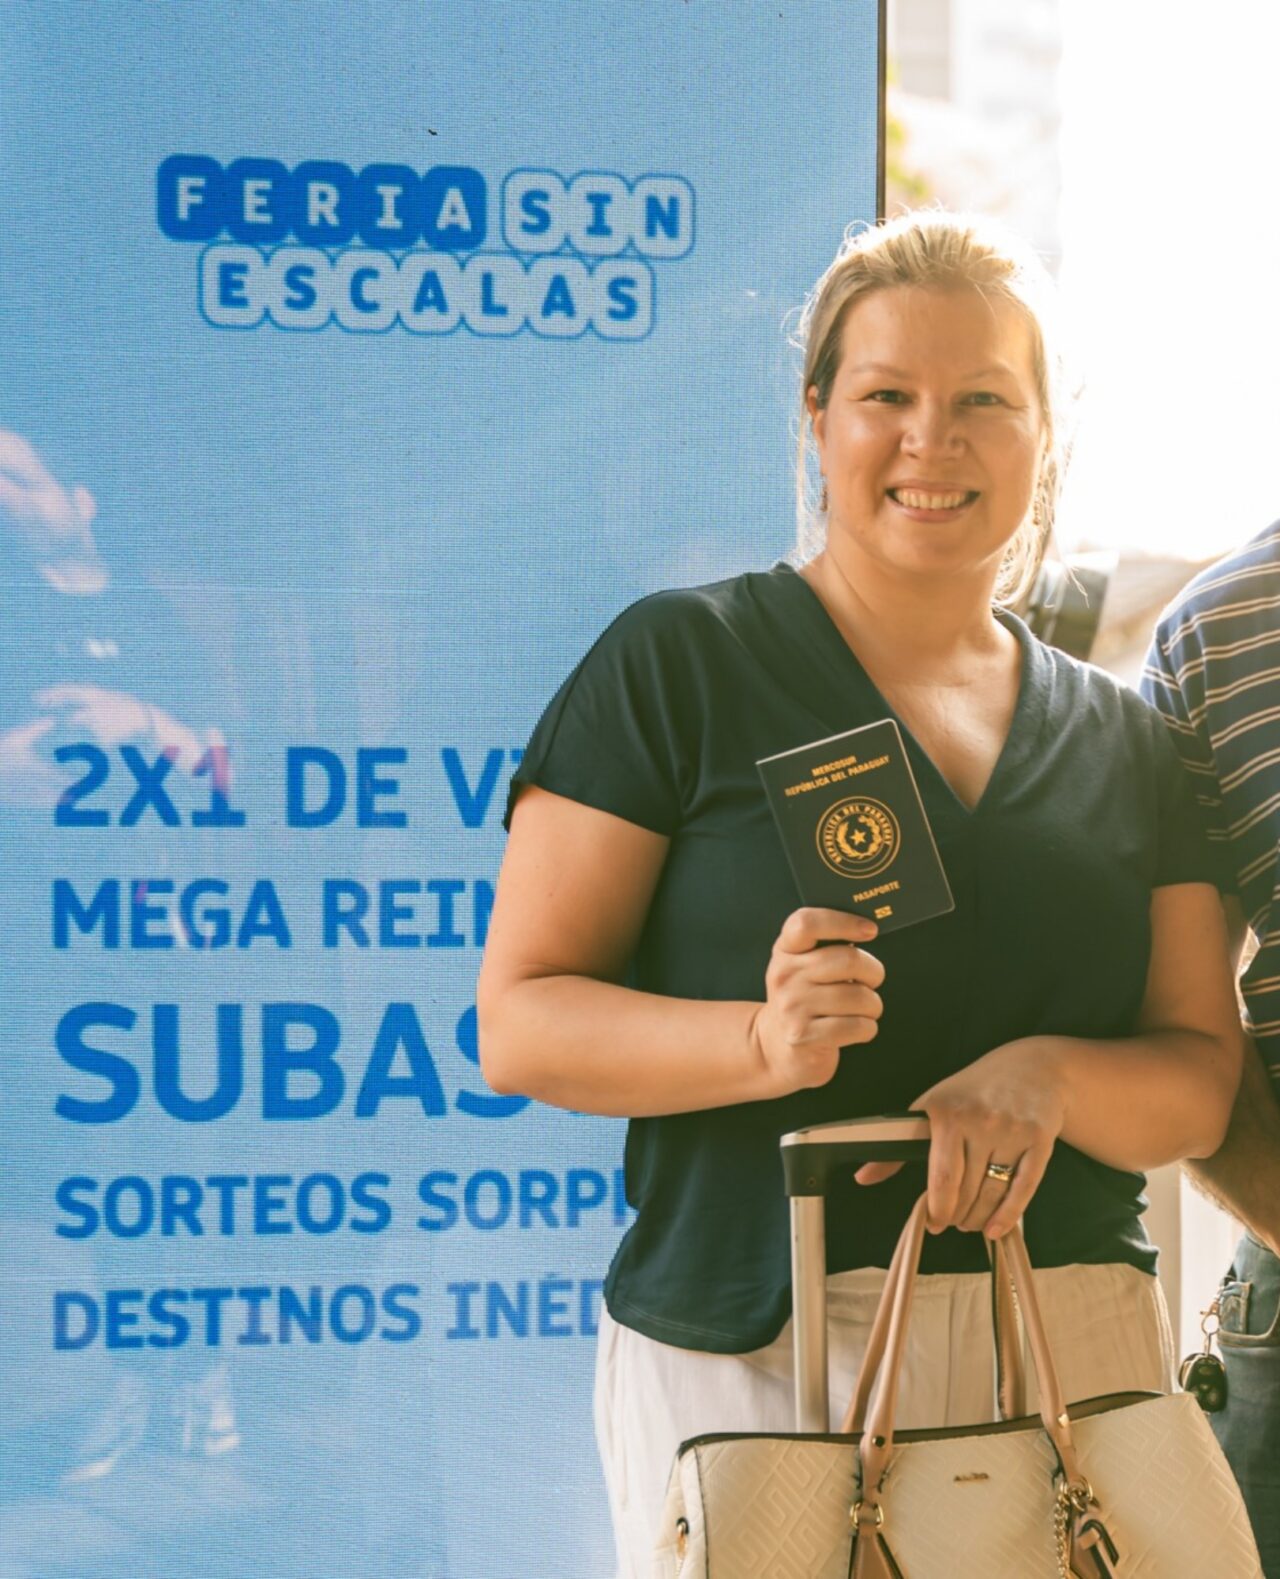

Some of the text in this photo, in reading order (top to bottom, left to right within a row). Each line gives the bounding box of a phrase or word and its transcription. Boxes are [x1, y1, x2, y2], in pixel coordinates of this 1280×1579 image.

[176, 176, 680, 241] FERIA SIN
[218, 262, 639, 321] ESCALAS
[53, 742, 247, 829] 2X1
[285, 746, 409, 829] DE
[812, 755, 857, 776] MERCOSUR
[831, 772, 847, 782] DEL
[848, 755, 889, 775] PARAGUAY
[51, 878, 293, 950] MEGA
[853, 880, 900, 902] PASAPORTE
[54, 1168, 629, 1239] SORTEOS SORP
[53, 1283, 422, 1351] DESTINOS
